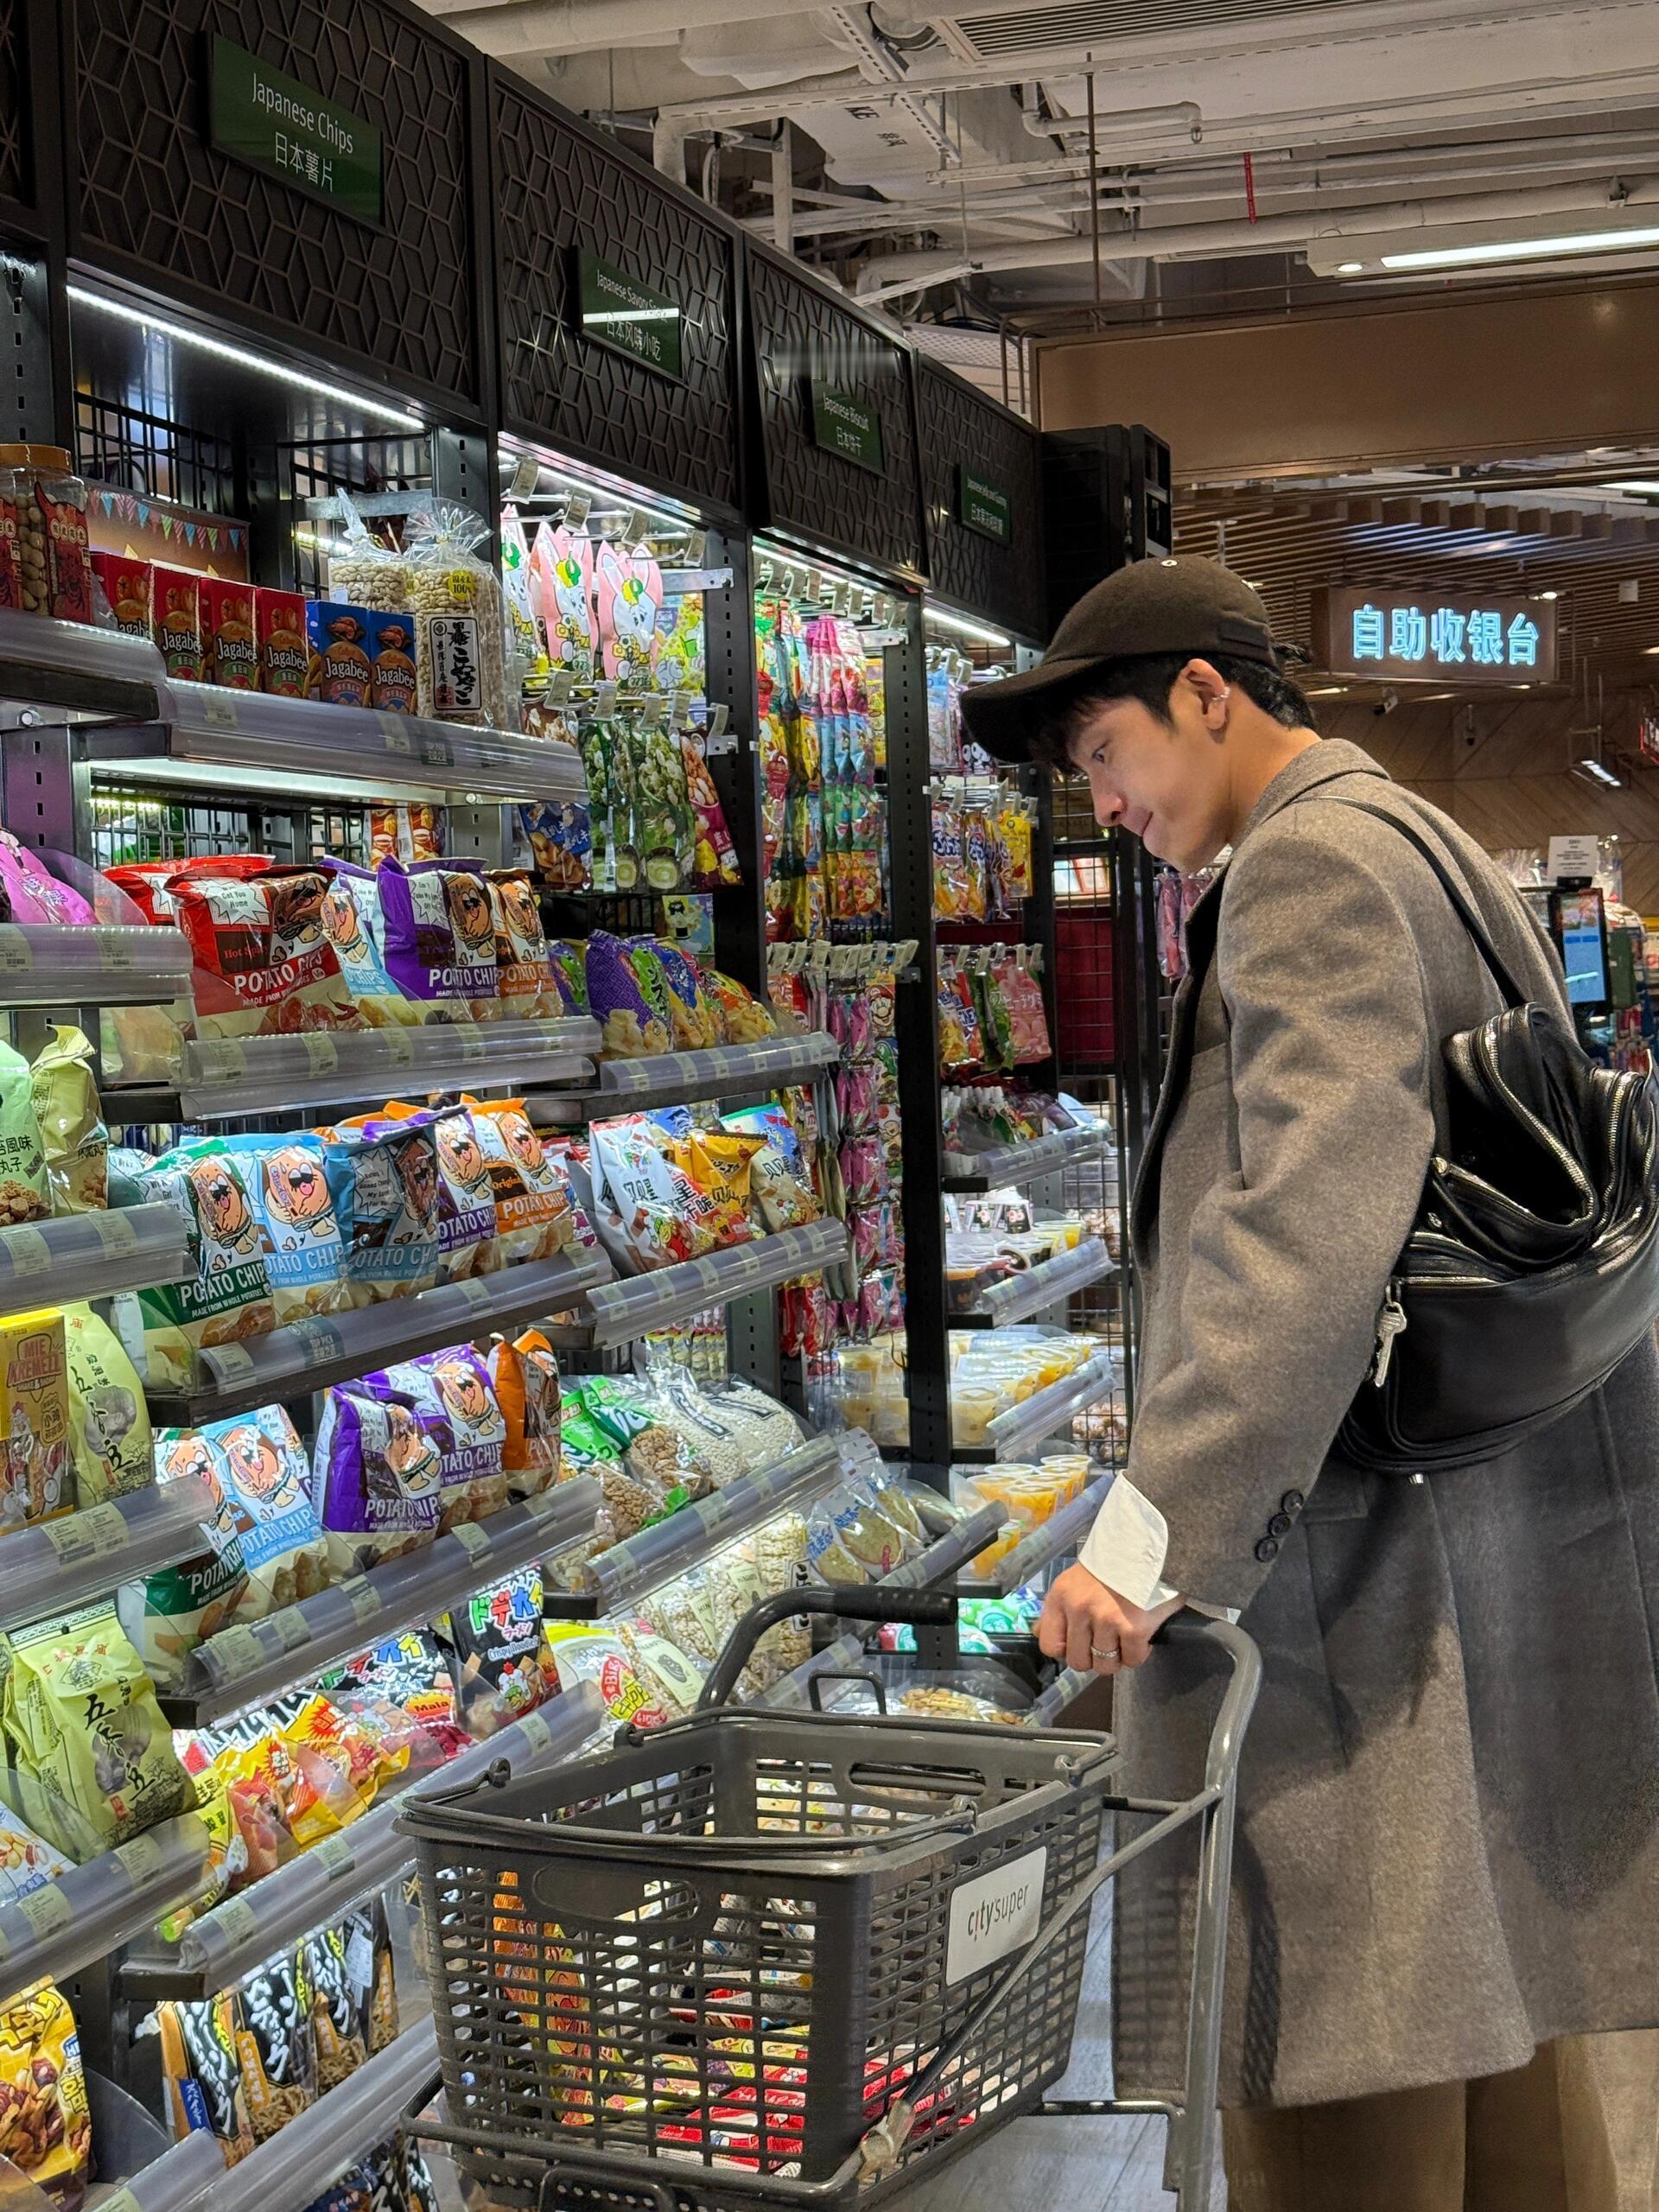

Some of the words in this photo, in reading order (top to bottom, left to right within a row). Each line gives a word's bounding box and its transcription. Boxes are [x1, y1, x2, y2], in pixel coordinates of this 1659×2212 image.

[252, 73, 315, 132] Japanese
[318, 112, 353, 156] Chips
[275, 131, 334, 193] 日本薯片
[596, 269, 626, 301] Japanese
[162, 628, 204, 657] Jagabee
[1352, 603, 1539, 666] 自助收银台
[218, 638, 257, 665] Jagabee
[268, 646, 308, 673] Jagabee
[325, 658, 369, 683] Jagabee
[376, 665, 416, 690] Jagabee
[234, 963, 295, 996] POTATO
[438, 1211, 476, 1241] OTATO
[355, 1248, 404, 1269] OTATO
[438, 1241, 451, 1251] ADE
[264, 1253, 302, 1275] OTATO
[222, 1294, 241, 1310] WHOLE
[503, 1621, 534, 1641] ラーメン
[487, 1644, 511, 1661] Crispy
[415, 1700, 449, 1713] Mala
